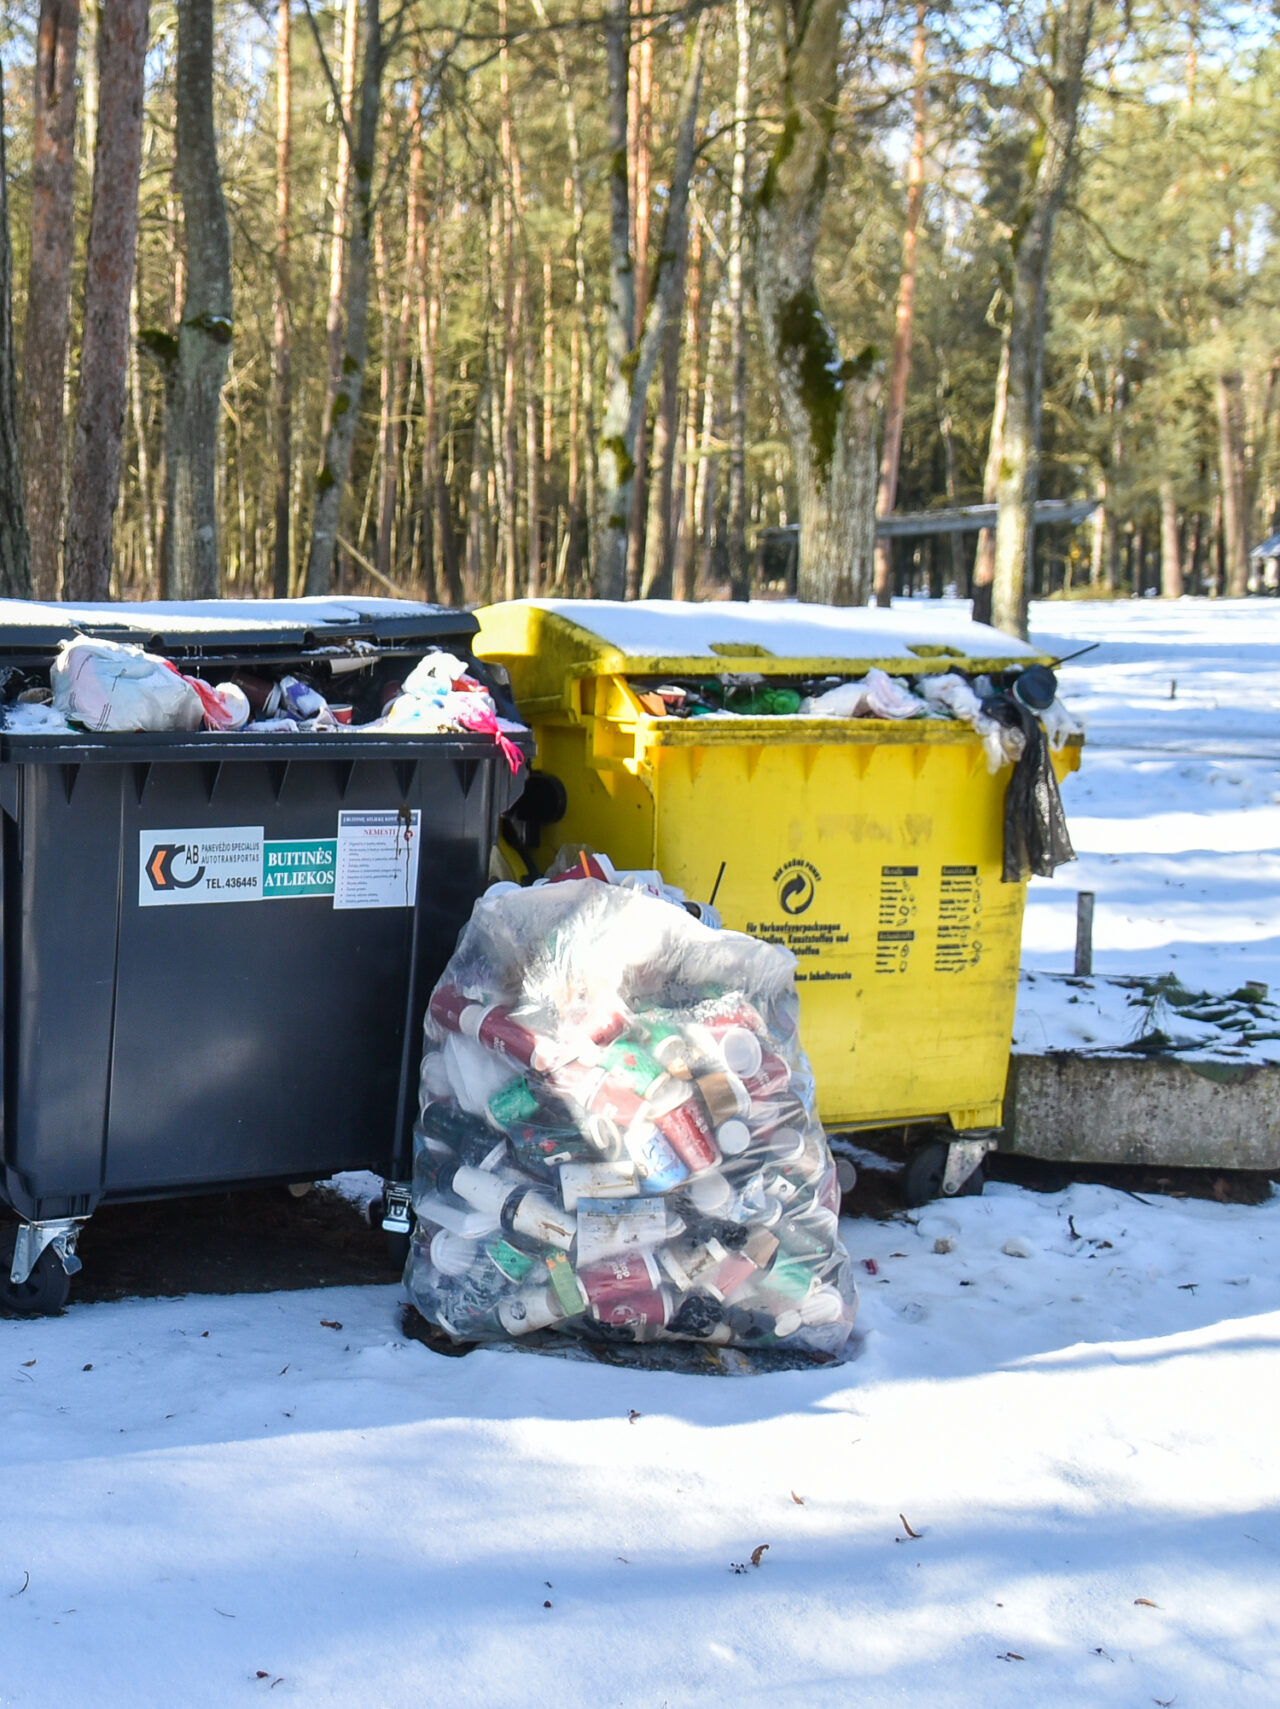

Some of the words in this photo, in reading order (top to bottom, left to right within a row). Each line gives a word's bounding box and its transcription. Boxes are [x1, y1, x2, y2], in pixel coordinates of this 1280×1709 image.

[185, 844, 199, 865] AB
[231, 842, 260, 851] SPECIALUS
[201, 853, 260, 864] AUTOTRANSPORTAS
[268, 846, 332, 867] BUITINĖS
[264, 870, 334, 887] ATLIEKOS
